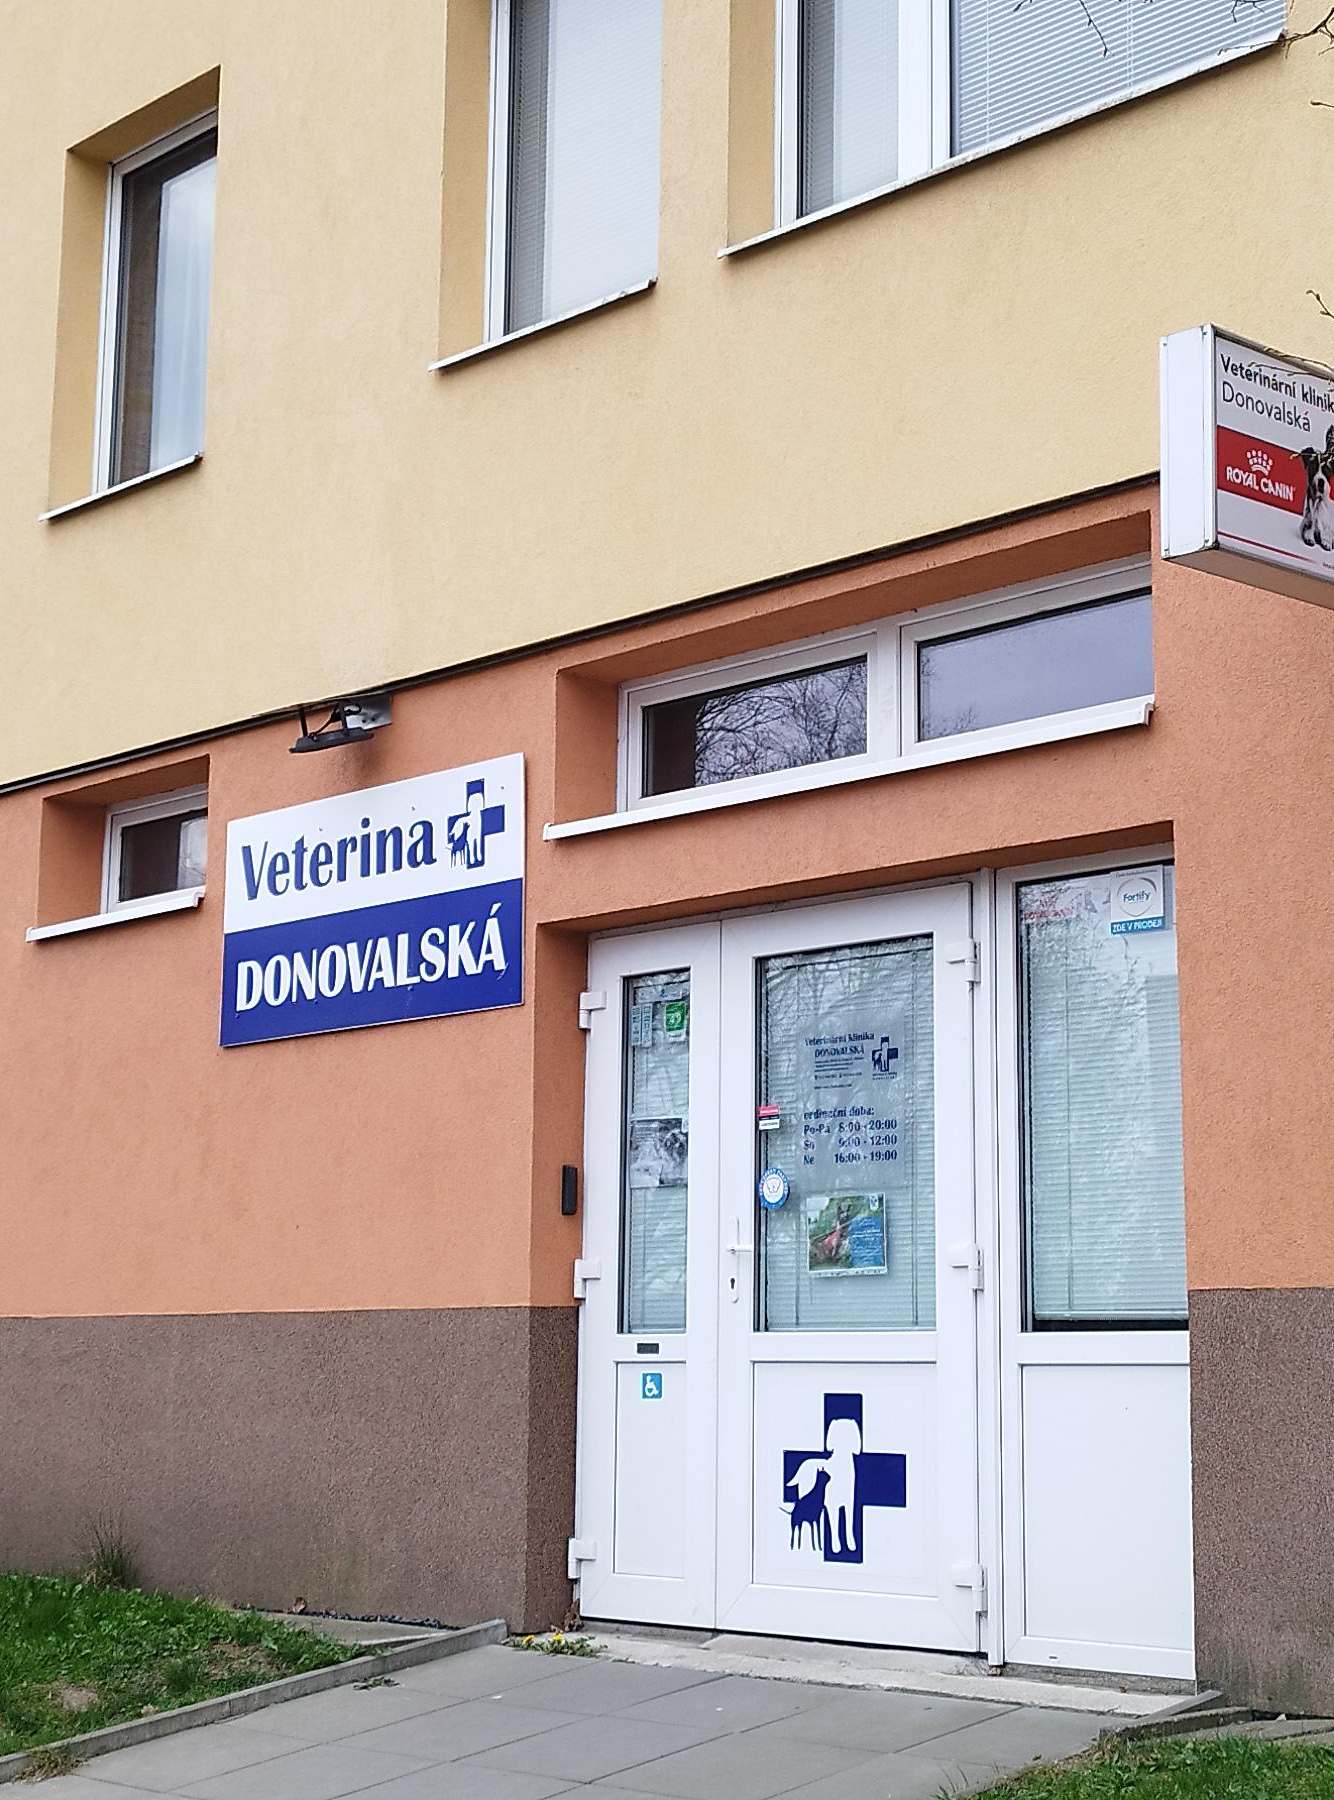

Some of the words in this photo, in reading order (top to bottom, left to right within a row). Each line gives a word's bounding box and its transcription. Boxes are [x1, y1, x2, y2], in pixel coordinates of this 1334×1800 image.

[1220, 353, 1297, 399] Veterinární
[1222, 381, 1311, 433] Donovalská
[1226, 466, 1259, 490] ROYAL
[1260, 477, 1294, 501] CANIN
[241, 817, 437, 901] Veterina
[1112, 922, 1125, 933] ZDE
[235, 902, 507, 1012] DONOVALSKÁ
[849, 1106, 874, 1117] doba:
[838, 1121, 861, 1132] 8:00
[868, 1119, 897, 1131] 20:00
[870, 1134, 897, 1146] 12:00
[804, 1155, 815, 1165] Ne
[834, 1152, 861, 1163] 16:00
[870, 1150, 897, 1161] 19:00
